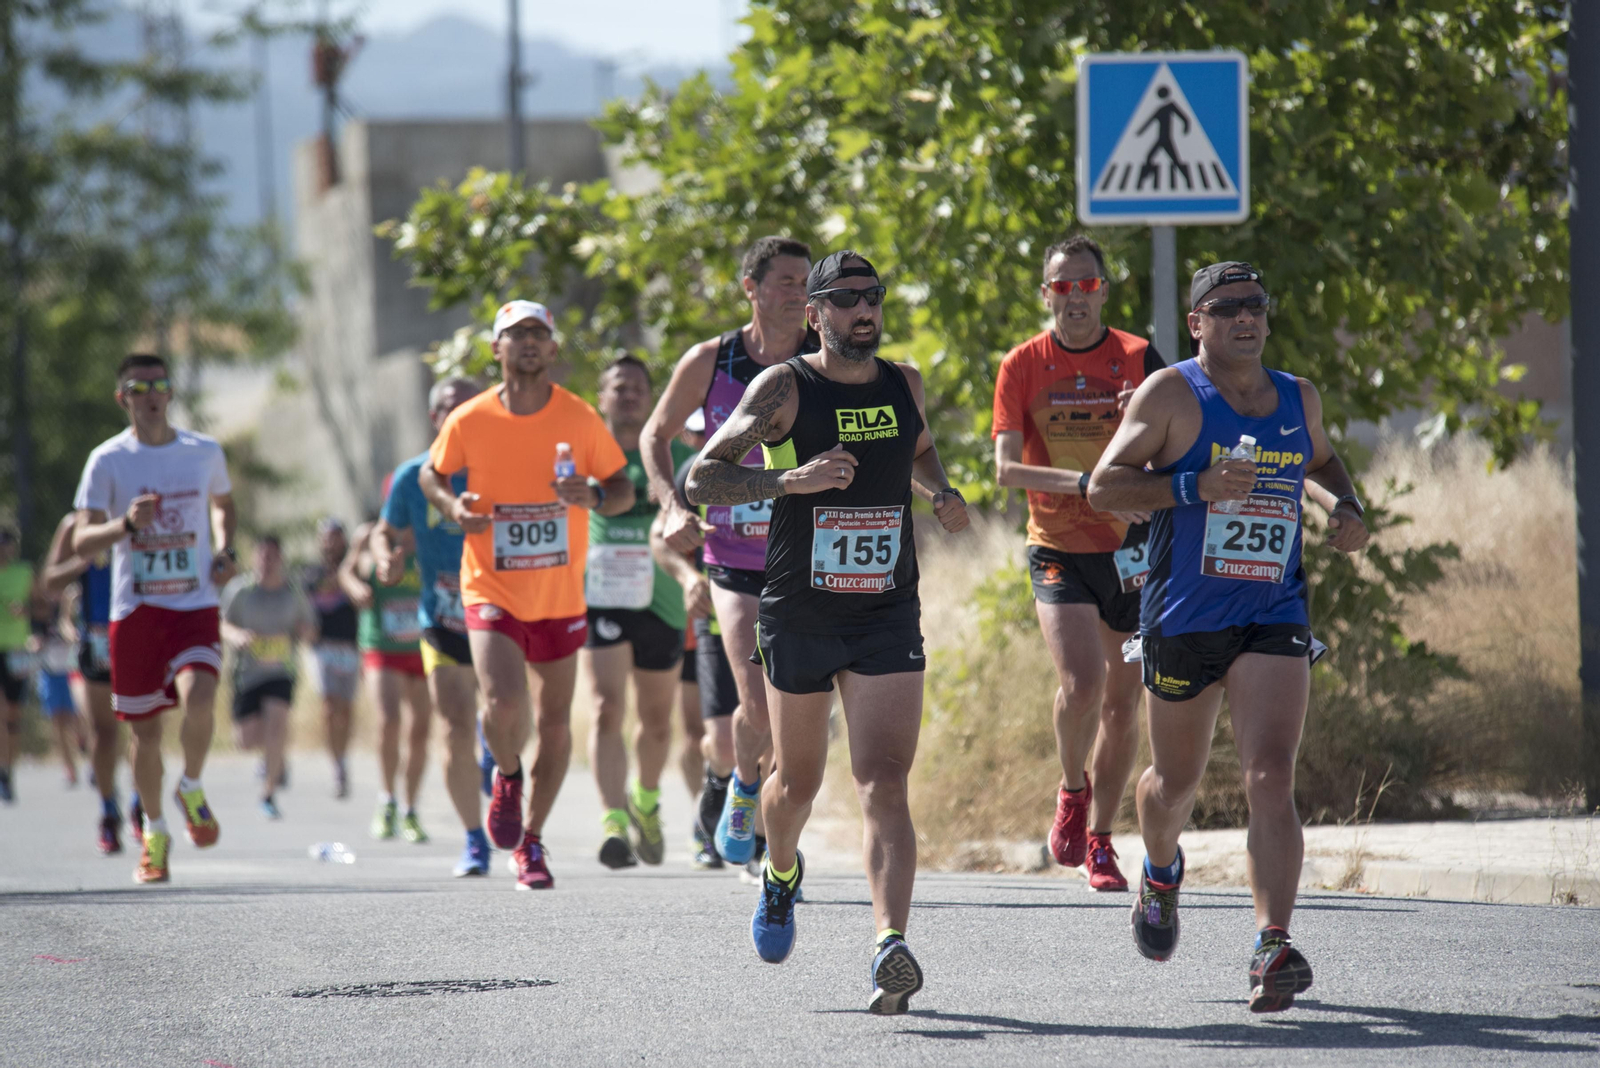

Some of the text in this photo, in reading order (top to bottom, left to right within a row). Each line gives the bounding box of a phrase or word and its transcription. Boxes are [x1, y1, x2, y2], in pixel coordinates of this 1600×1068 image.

[839, 409, 893, 430] FILA
[839, 428, 899, 442] ROAD RUNNER
[1249, 497, 1269, 507] Premio
[1270, 499, 1277, 507] de
[839, 511, 853, 519] Gran
[854, 511, 873, 519] Premio
[875, 511, 882, 519] de
[882, 510, 895, 518] Fond
[508, 521, 557, 546] 909
[1222, 521, 1286, 554] 258
[833, 535, 891, 566] 155
[143, 550, 188, 573] 718
[1215, 559, 1280, 580] Cruzcamp
[825, 574, 887, 591] Cruzcamp
[1162, 676, 1190, 687] olimpo
